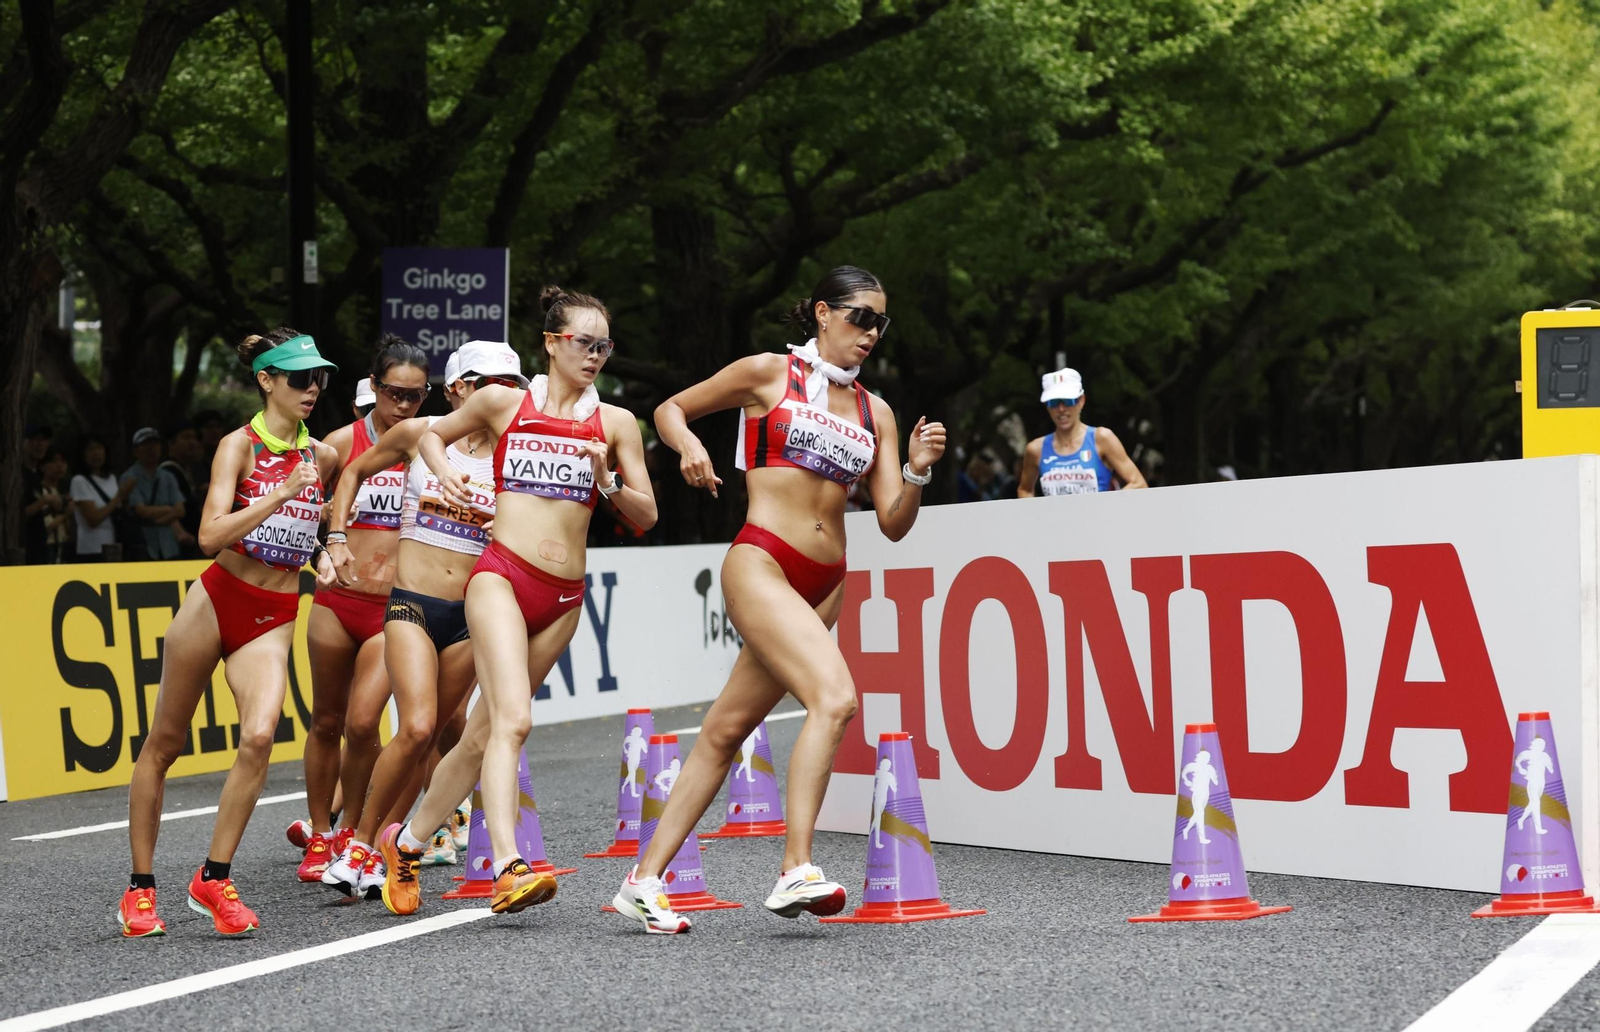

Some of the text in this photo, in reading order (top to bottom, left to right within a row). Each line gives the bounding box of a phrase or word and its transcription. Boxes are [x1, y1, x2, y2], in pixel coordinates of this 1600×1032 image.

[403, 267, 486, 295] Ginkgo
[386, 298, 502, 319] Tree Lane
[417, 328, 471, 356] Split
[775, 422, 791, 434] PE
[795, 407, 872, 448] HONDA
[508, 439, 592, 459] HOND
[789, 428, 828, 460] GARCÍA
[828, 442, 853, 469] LEÓN
[362, 476, 403, 487] HON
[509, 458, 592, 486] YANG 114
[1043, 473, 1094, 481] HONDA
[369, 494, 403, 511] WU
[257, 525, 306, 549] GONZÁLEZ
[830, 542, 1509, 815] HONDA
